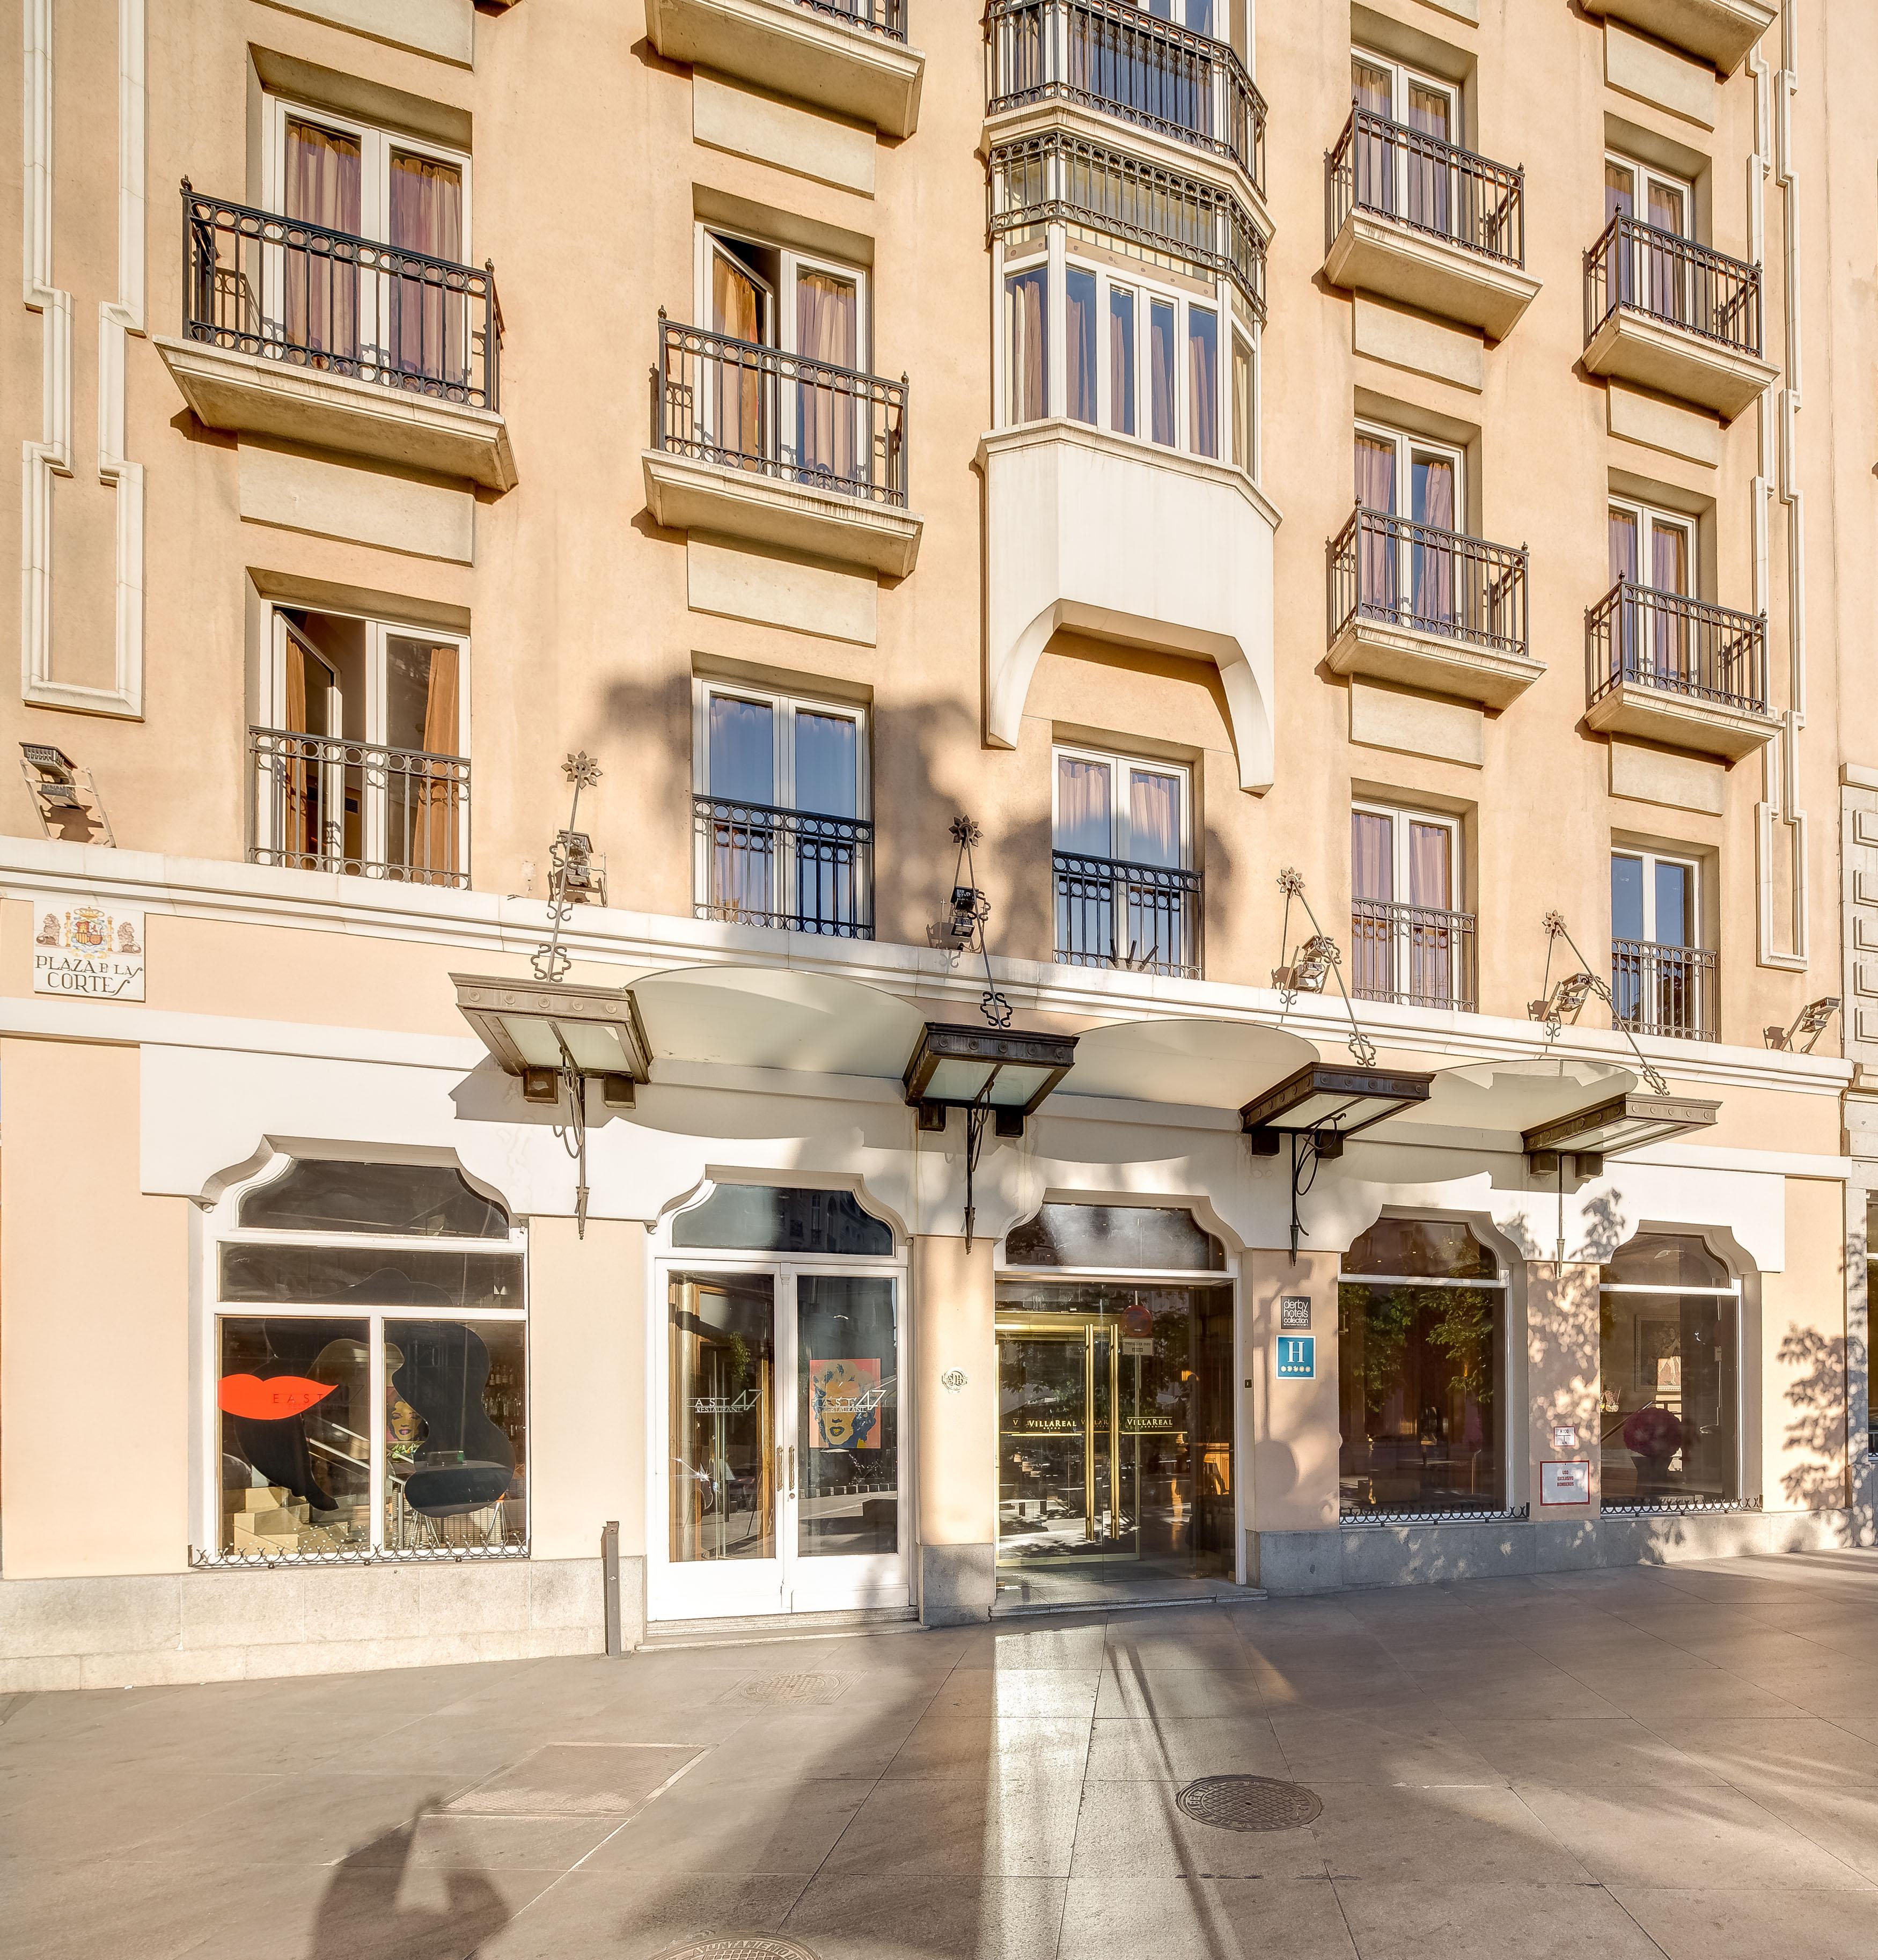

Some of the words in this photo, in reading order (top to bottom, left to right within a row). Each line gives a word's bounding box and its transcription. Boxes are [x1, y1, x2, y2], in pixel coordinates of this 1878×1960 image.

[35, 955, 96, 974] PLAZA
[114, 964, 143, 978] LAS
[47, 972, 130, 996] CORTES
[1283, 1298, 1308, 1311] derby
[1283, 1308, 1308, 1318] hotels
[1287, 1341, 1305, 1363] H
[685, 1398, 727, 1407] AST
[730, 1389, 764, 1411] 47
[855, 1389, 887, 1411] 47
[693, 1941, 789, 1956] AYUNTAMIENTO
